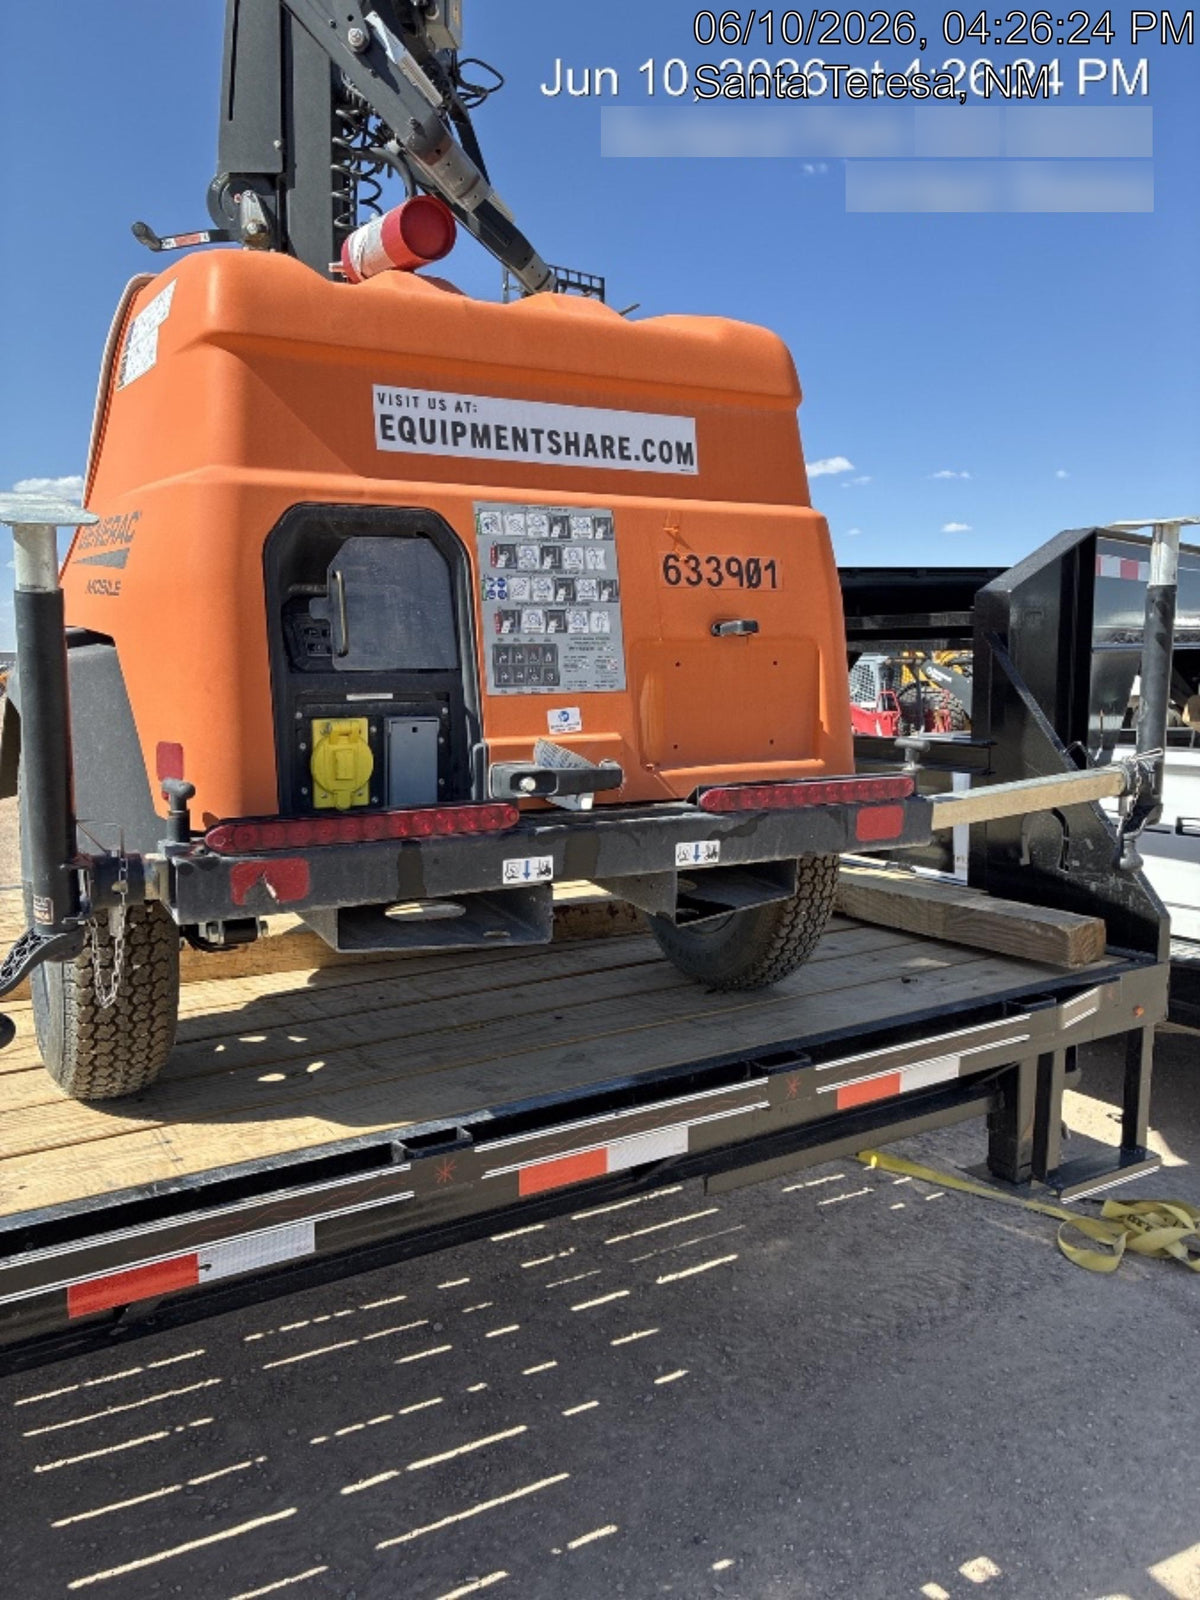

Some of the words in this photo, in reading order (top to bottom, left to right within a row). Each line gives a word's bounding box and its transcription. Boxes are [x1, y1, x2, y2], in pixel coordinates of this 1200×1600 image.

[377, 392, 420, 409] VISIT
[427, 397, 448, 412] US
[454, 400, 478, 414] AT:
[379, 413, 696, 467] EQUIPMENTSHARE.COM
[662, 553, 777, 590] 633901
